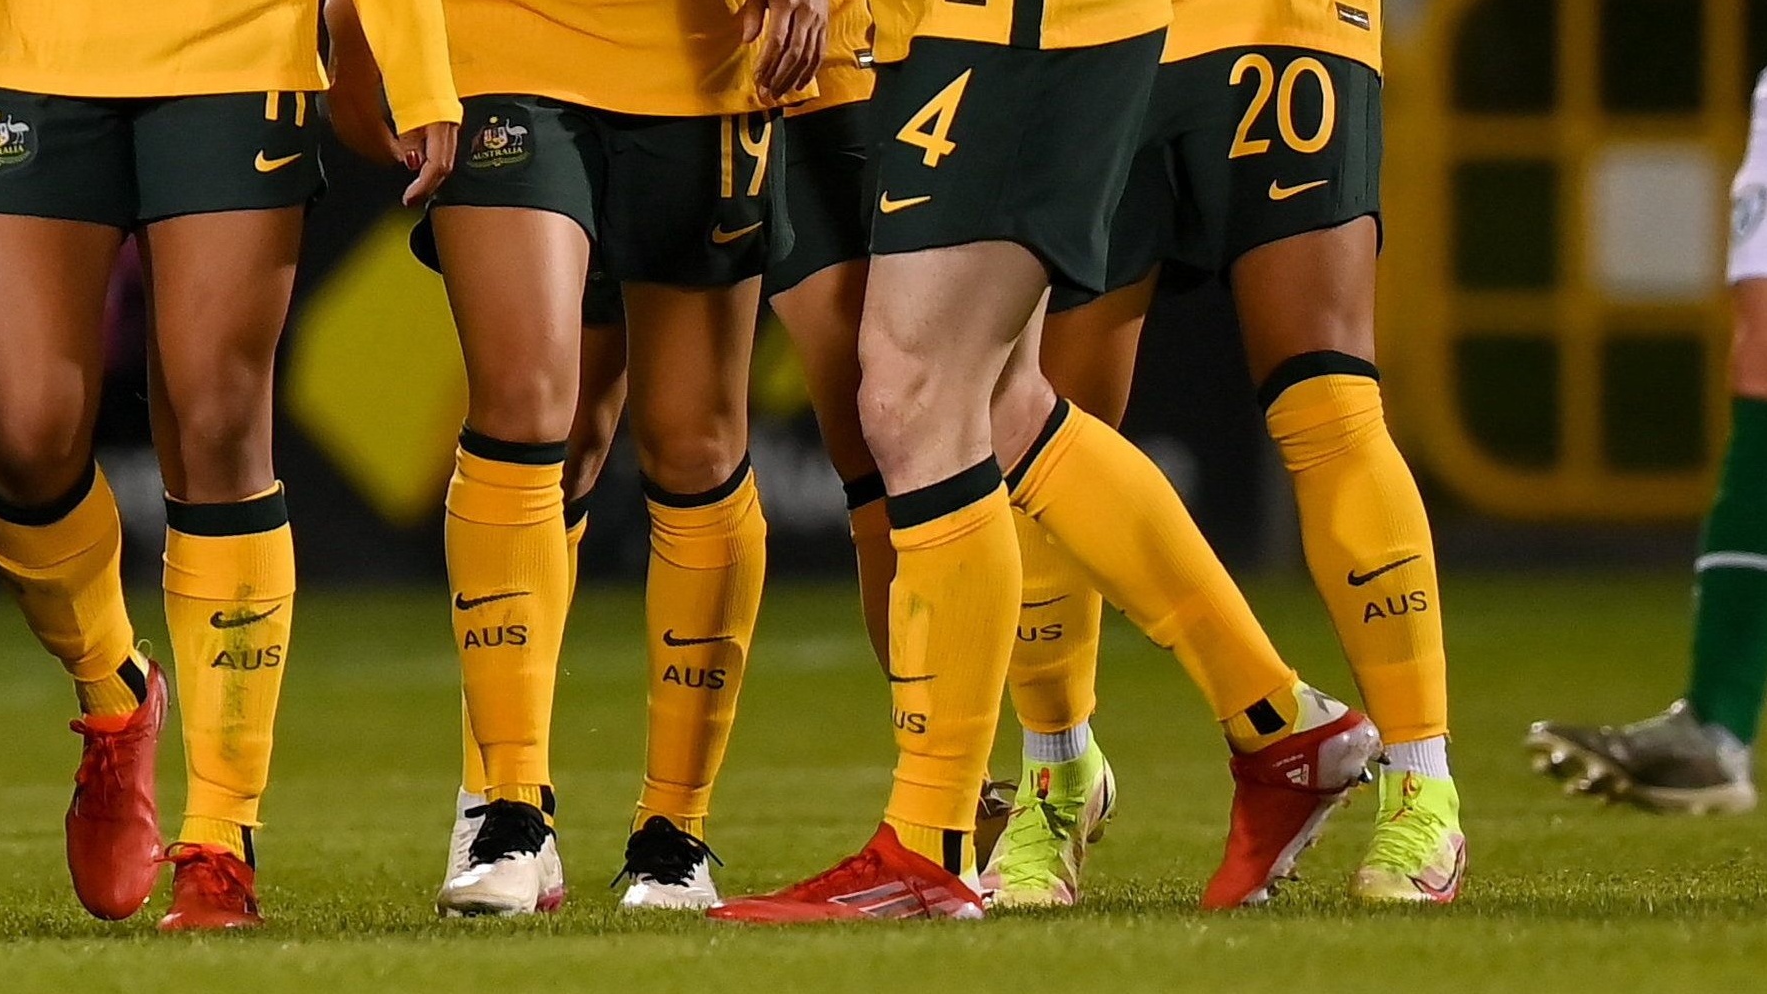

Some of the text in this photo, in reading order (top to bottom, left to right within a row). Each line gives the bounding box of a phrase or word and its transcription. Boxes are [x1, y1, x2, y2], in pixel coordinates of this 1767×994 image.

[894, 66, 973, 169] 4
[1227, 52, 1336, 160] 20
[472, 146, 524, 161] AUSTRALIA
[1363, 591, 1429, 624] AUS
[463, 624, 528, 650] AUS
[1016, 623, 1063, 642] US
[210, 644, 283, 671] AUS
[662, 664, 727, 690] AUS
[894, 706, 927, 734] US
